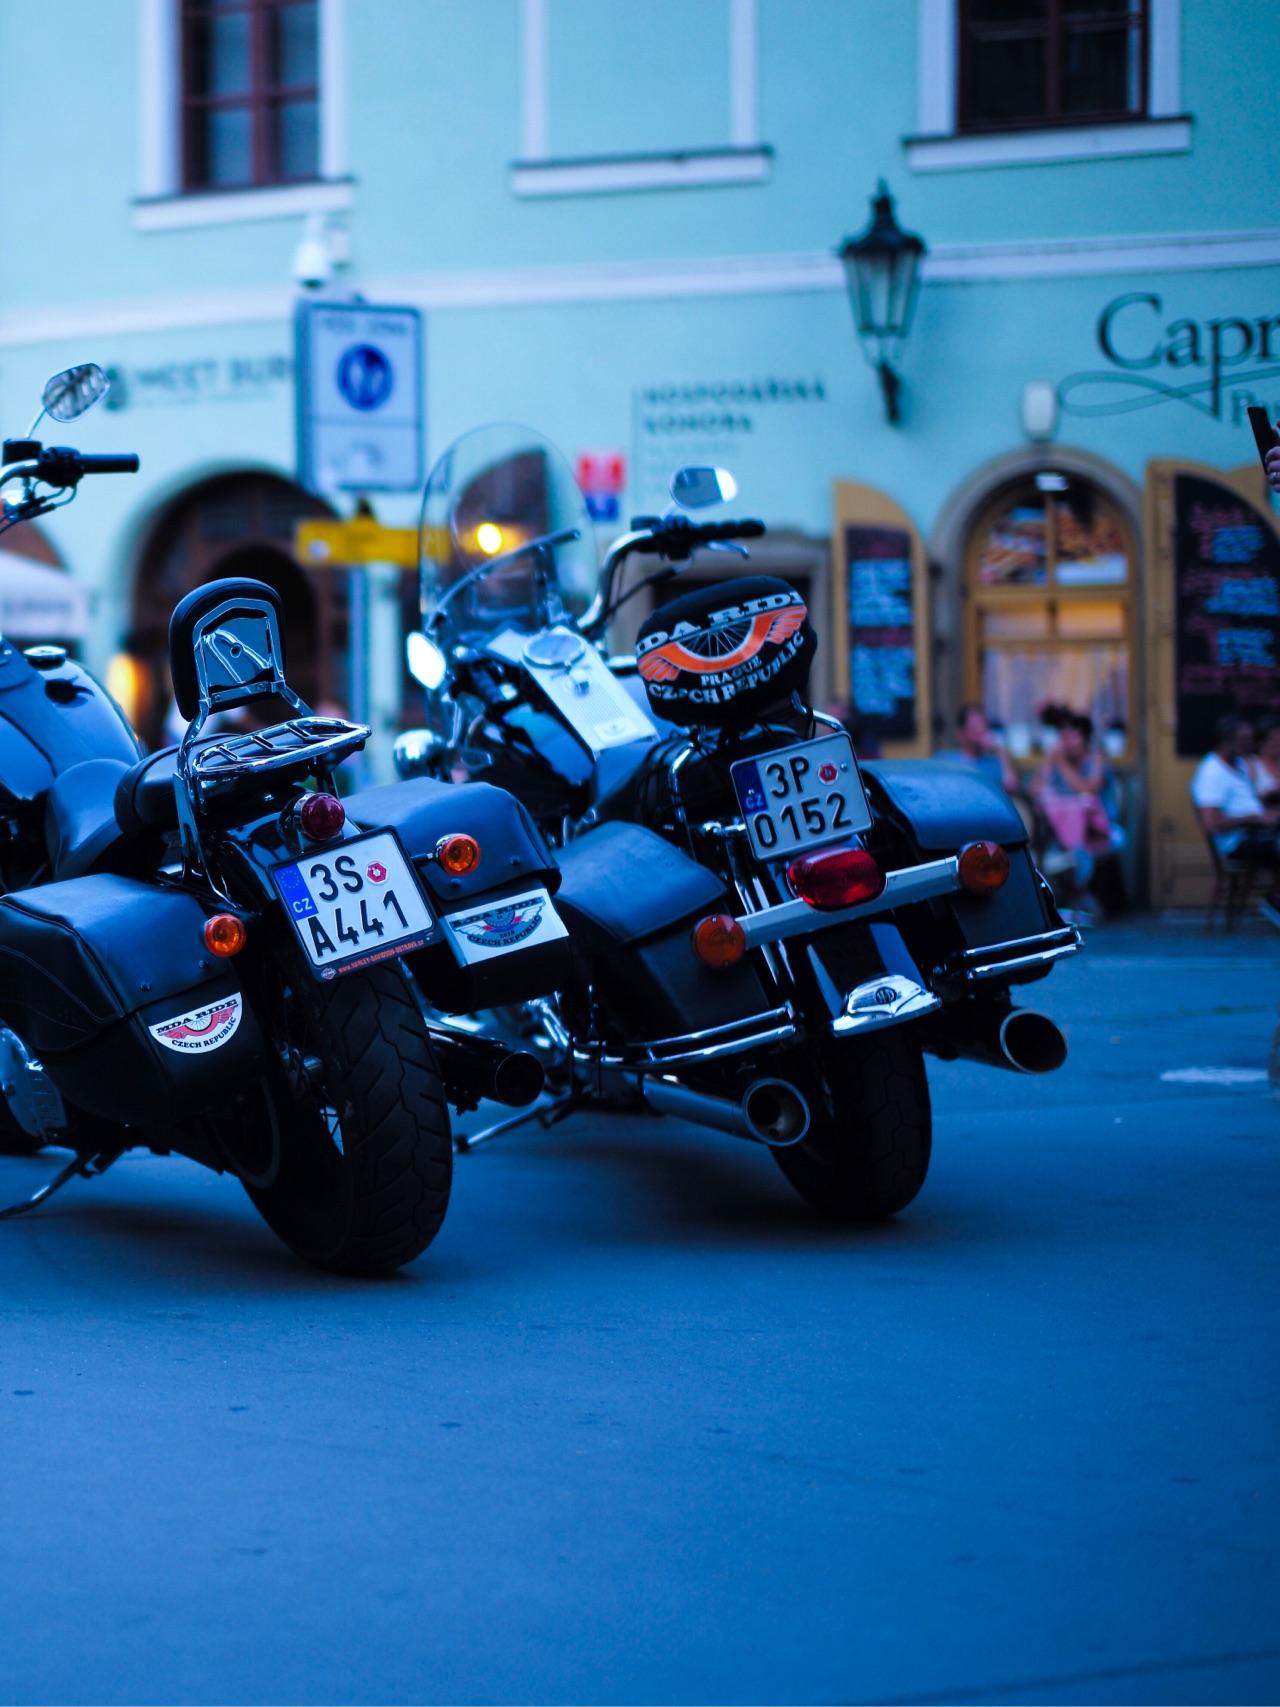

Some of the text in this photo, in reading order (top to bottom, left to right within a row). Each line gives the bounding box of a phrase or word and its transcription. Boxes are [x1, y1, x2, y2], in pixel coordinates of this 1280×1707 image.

[701, 655, 763, 687] PRAGUE
[722, 631, 805, 700] REPUBLIC
[766, 755, 810, 799] 3P
[745, 794, 764, 809] CZ
[753, 792, 853, 848] 0152
[310, 855, 364, 902] 3S
[292, 897, 313, 913] CZ
[307, 889, 409, 958] A441
[156, 999, 238, 1034] MDA RIDE
[171, 1016, 237, 1048] CZECH REPUBLIC
